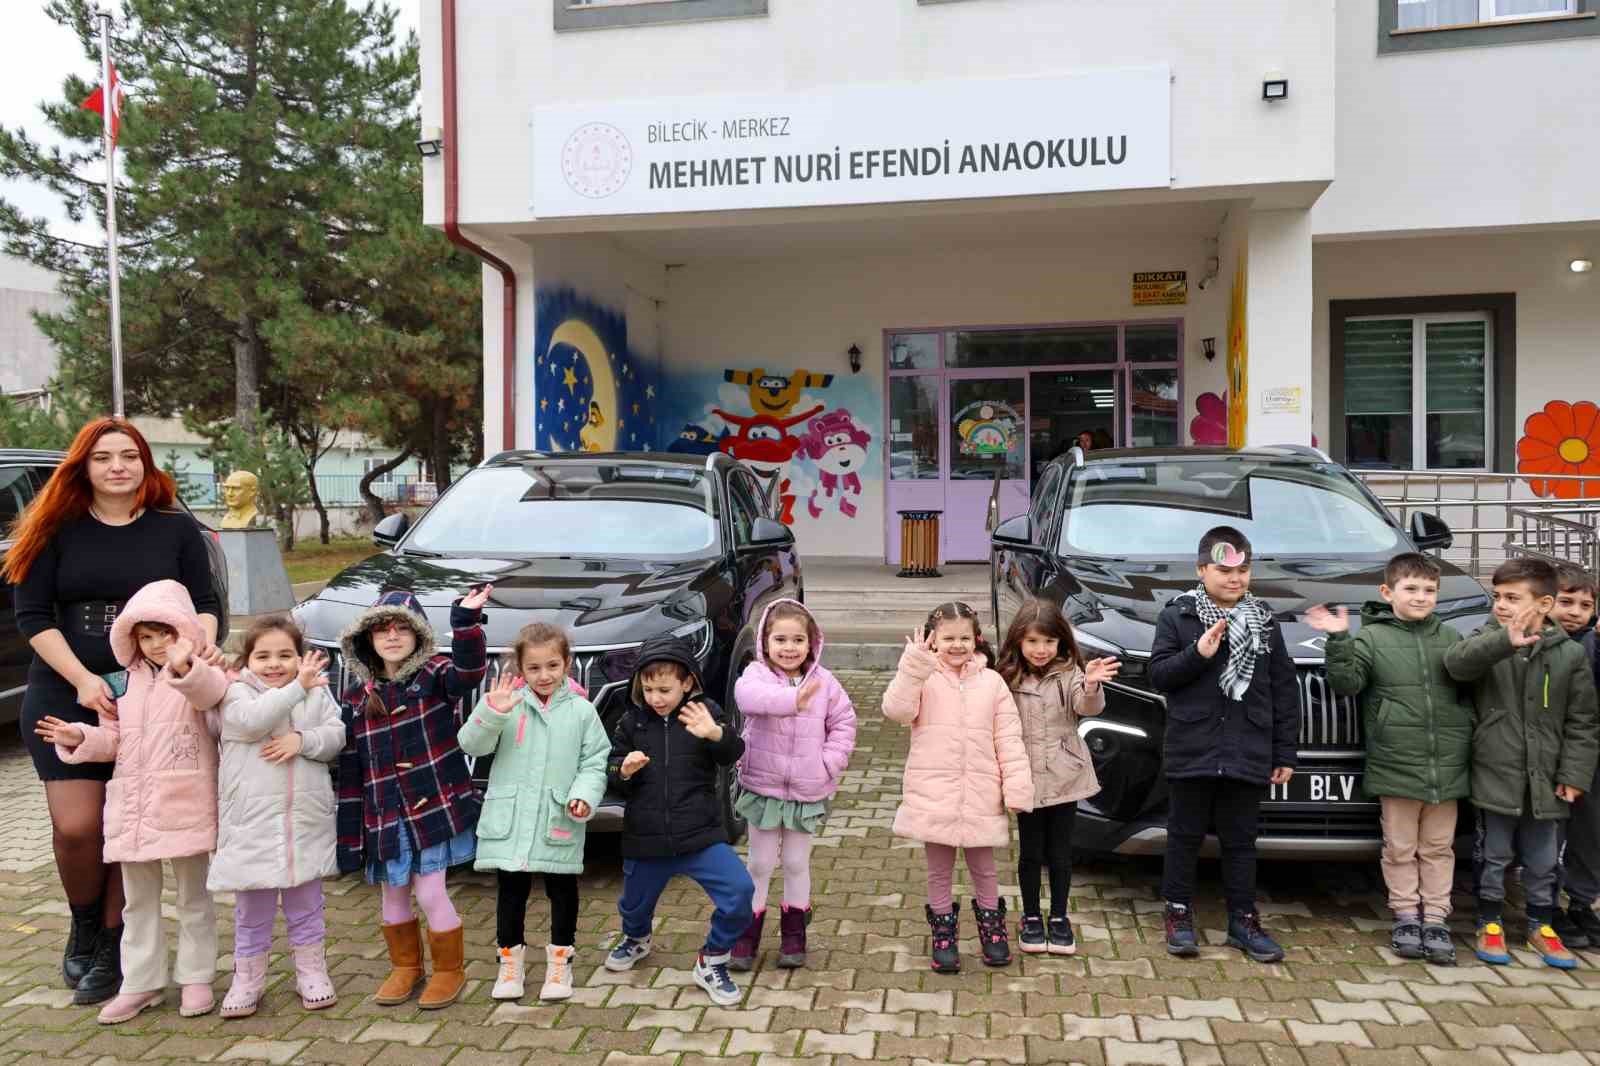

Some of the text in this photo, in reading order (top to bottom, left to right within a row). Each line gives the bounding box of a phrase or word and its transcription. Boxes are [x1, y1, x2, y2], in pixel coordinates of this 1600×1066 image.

[648, 119, 708, 143] BİLECİK
[722, 117, 791, 139] MERKEZ
[649, 135, 1128, 189] MEHMET NURİ EFENDİ ANAOKULU
[1310, 775, 1355, 801] BLV
